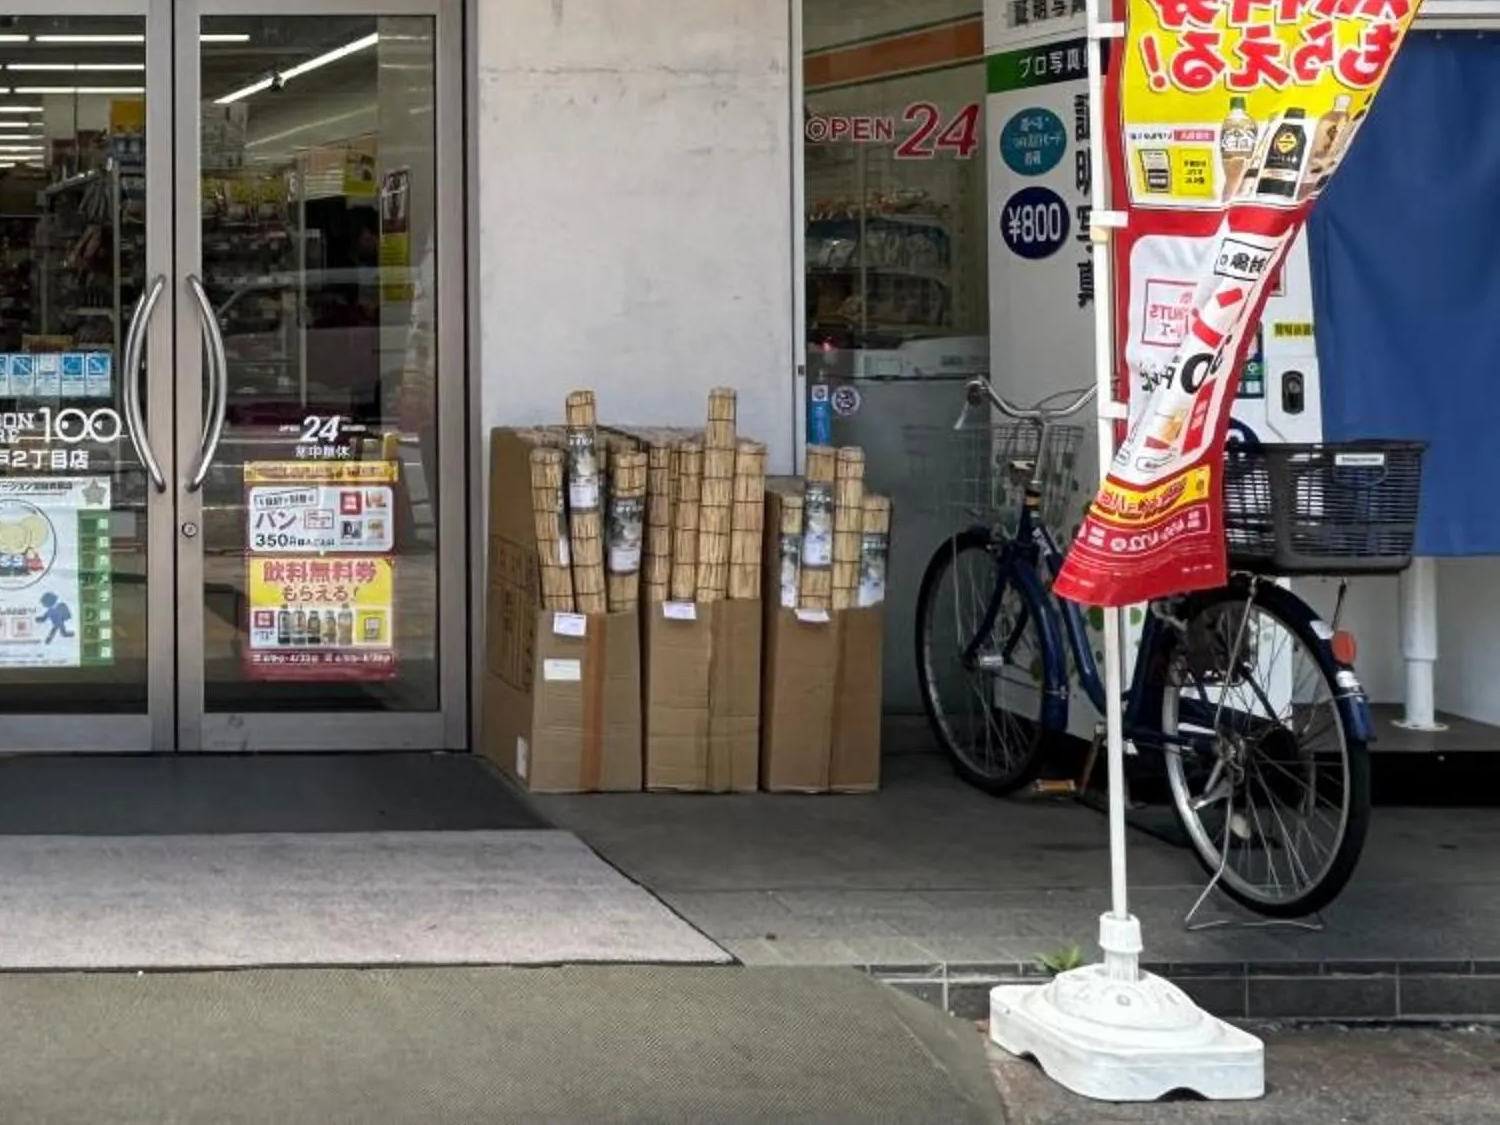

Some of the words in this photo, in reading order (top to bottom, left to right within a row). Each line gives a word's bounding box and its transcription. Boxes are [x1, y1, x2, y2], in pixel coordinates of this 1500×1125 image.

[1019, 44, 1088, 78] プロ写真
[805, 117, 895, 142] OPEN
[895, 101, 981, 159] 24
[1008, 203, 1062, 244] ¥800
[38, 407, 122, 443] 100
[300, 416, 341, 443] 24
[256, 508, 297, 531] パン
[263, 561, 377, 584] 飲料無料券
